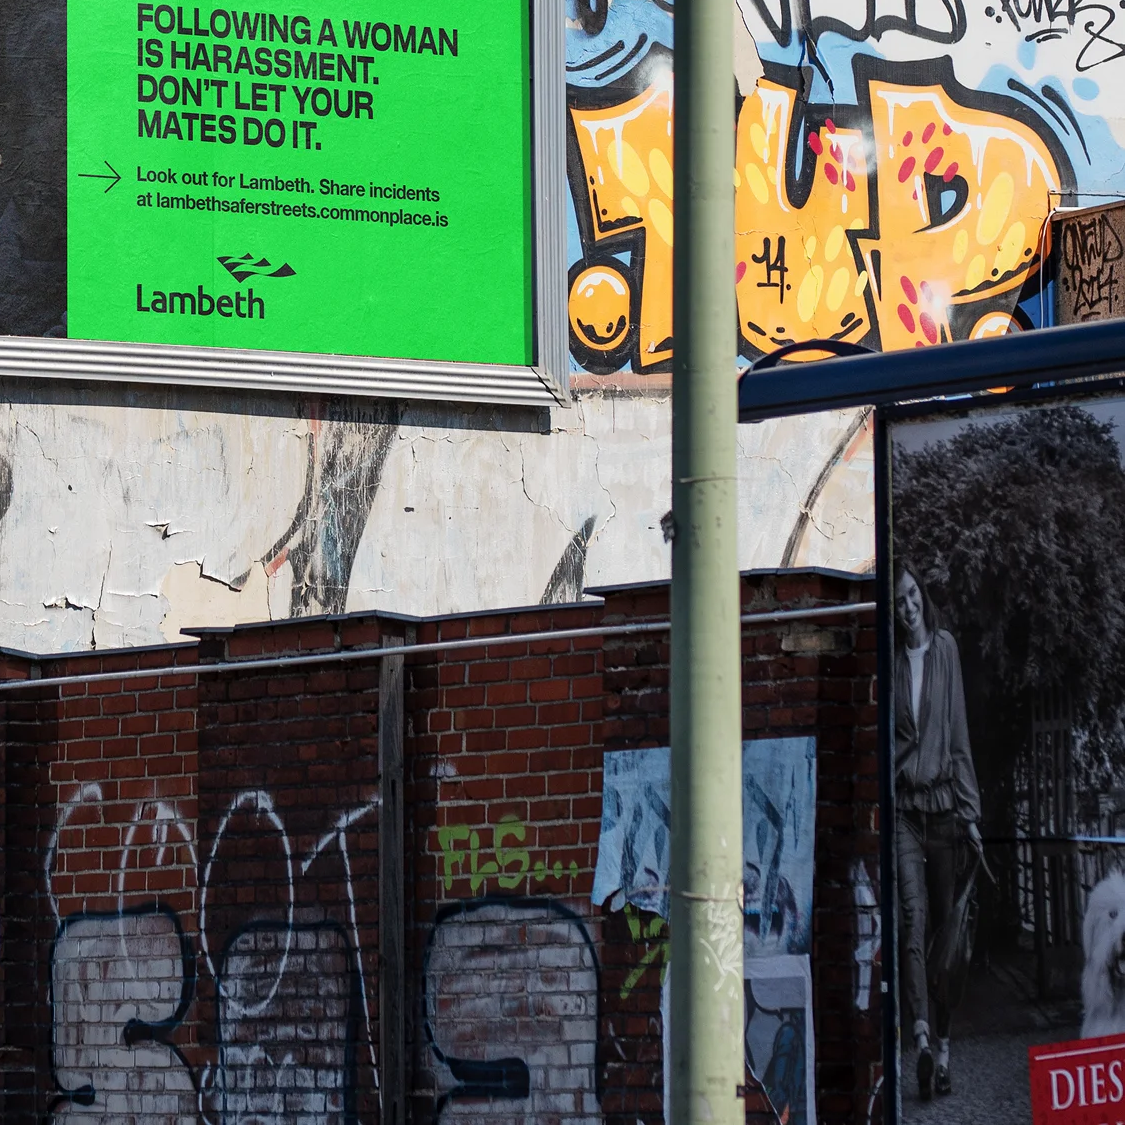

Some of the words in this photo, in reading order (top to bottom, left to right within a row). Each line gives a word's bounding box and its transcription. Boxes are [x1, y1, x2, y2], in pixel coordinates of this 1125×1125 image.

[137, 2, 312, 45] FOLLOWING
[316, 18, 338, 48] A
[342, 19, 458, 57] WOMAN
[137, 38, 164, 69] IS
[170, 40, 379, 85] HARASSMENT.
[234, 81, 287, 113] LET
[291, 85, 374, 120] YOUR
[138, 108, 237, 145] MATES
[243, 116, 286, 148] DO
[292, 120, 322, 151] IT.
[137, 165, 178, 184] Look
[181, 172, 209, 186] out
[211, 171, 236, 188] for
[239, 173, 315, 194] Lambeth.
[319, 178, 366, 197] Share
[369, 184, 441, 203] incidents
[136, 192, 153, 207] at
[156, 192, 449, 228] lambethsaferstreets.commonplace.is
[136, 283, 265, 320] Lambeth
